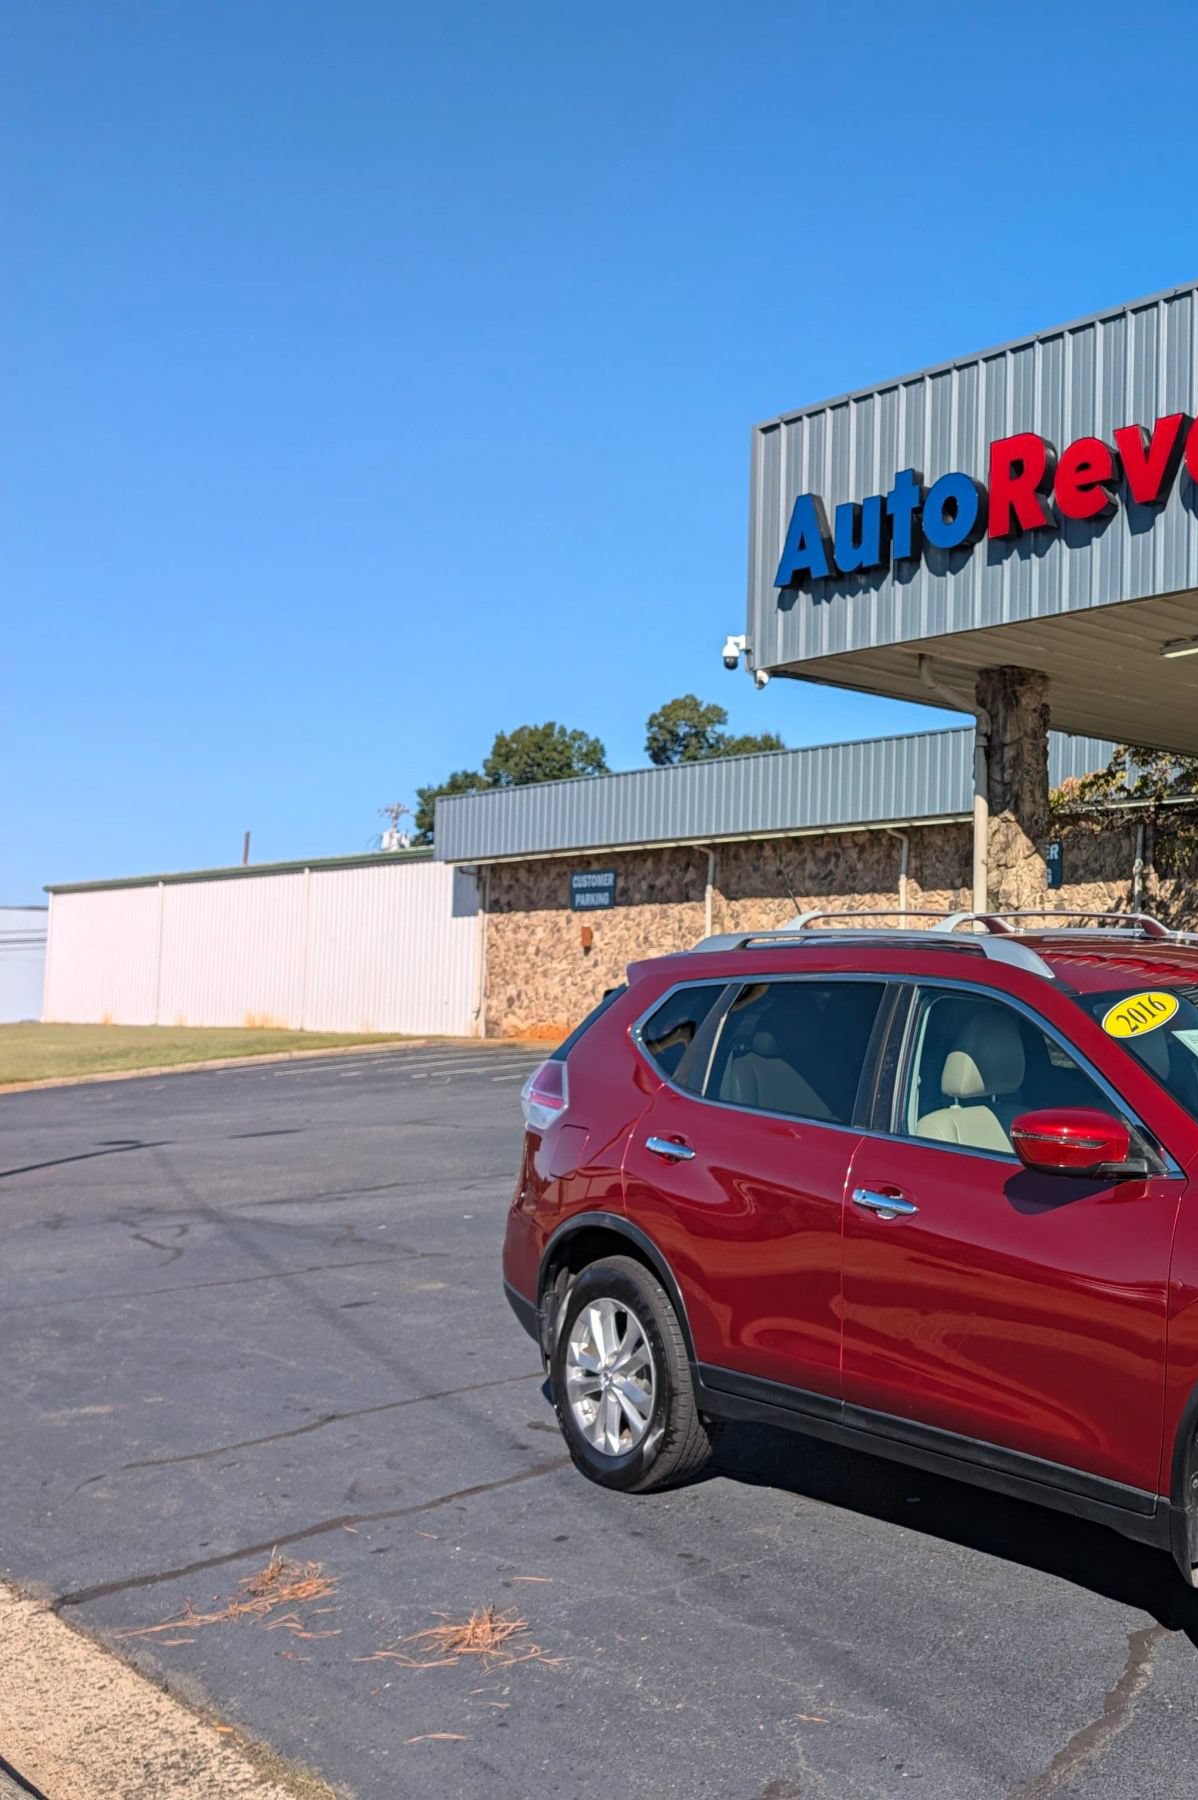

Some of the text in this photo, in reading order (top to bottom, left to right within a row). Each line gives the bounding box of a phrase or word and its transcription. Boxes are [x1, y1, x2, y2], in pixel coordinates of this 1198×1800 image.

[572, 873, 614, 888] CUSTOMER
[575, 893, 610, 906] PARKING
[1116, 995, 1167, 1033] 2016
